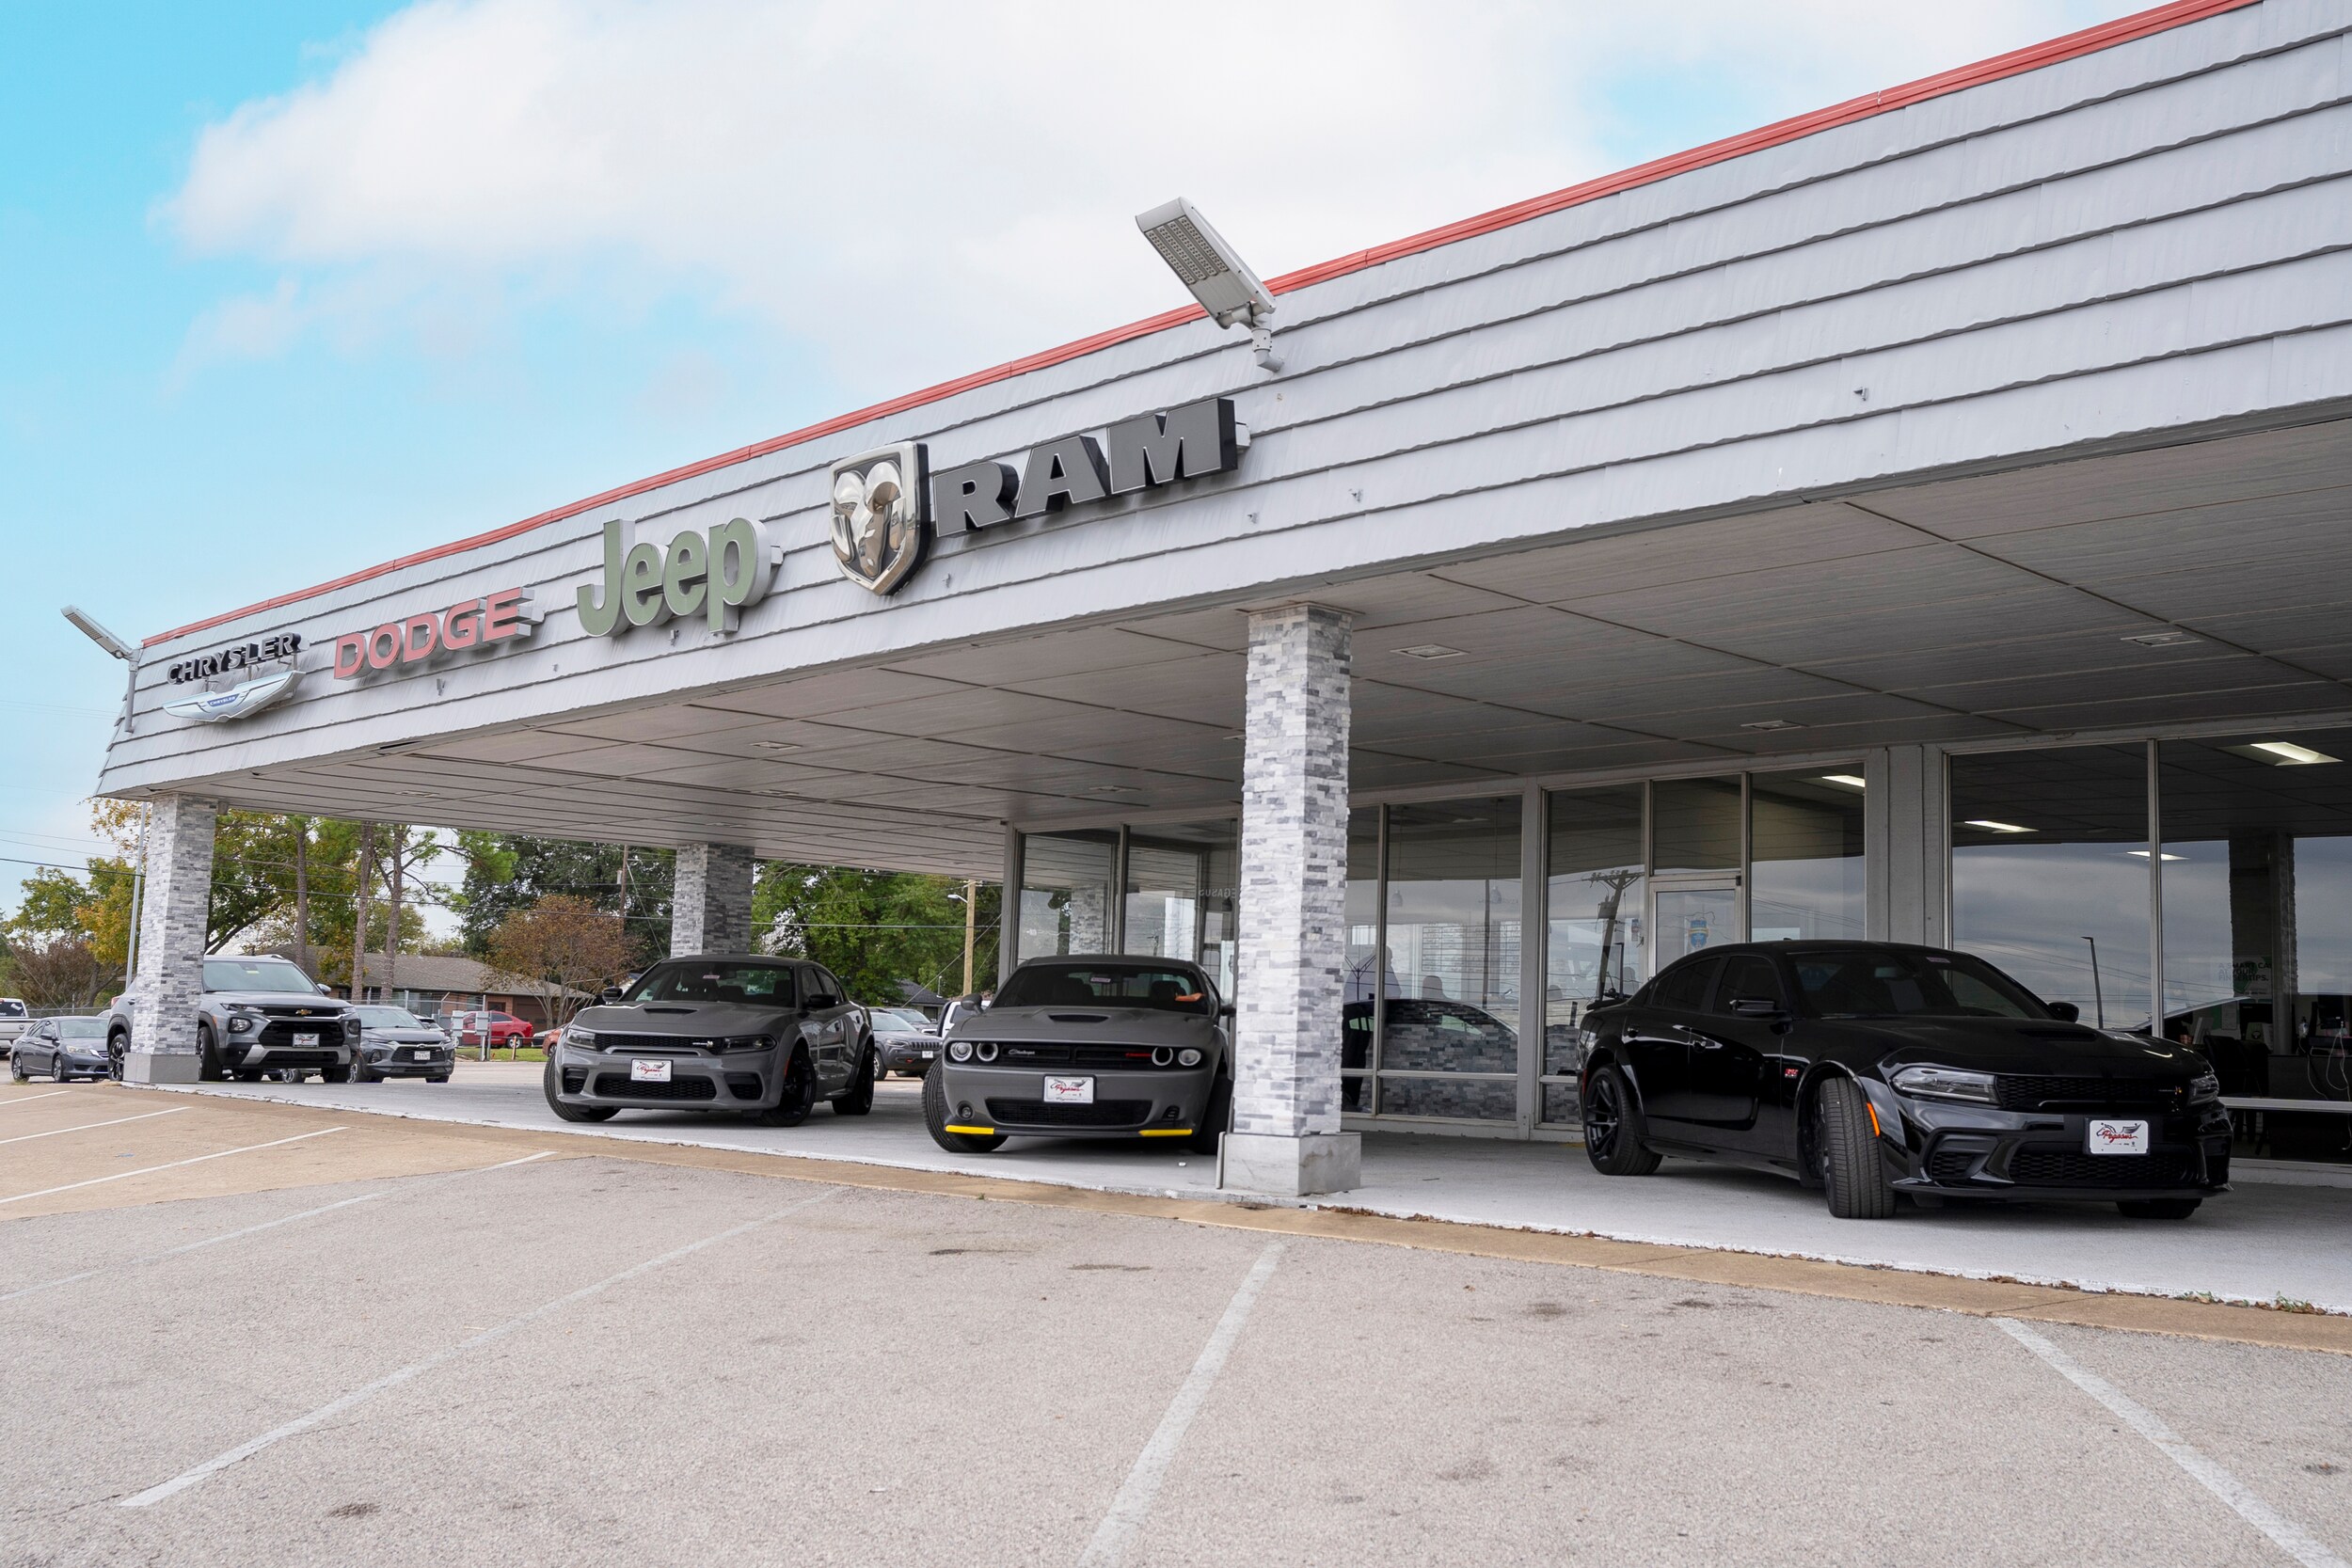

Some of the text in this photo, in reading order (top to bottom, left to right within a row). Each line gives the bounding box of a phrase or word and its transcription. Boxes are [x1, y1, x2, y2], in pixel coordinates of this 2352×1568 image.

[933, 398, 1232, 538] RAM
[576, 516, 766, 638] Jeep
[167, 632, 302, 686] CHRYSLER
[333, 587, 529, 680] DODGE
[210, 695, 236, 705] CHRYSLER
[2102, 1130, 2138, 1144] Pegasus
